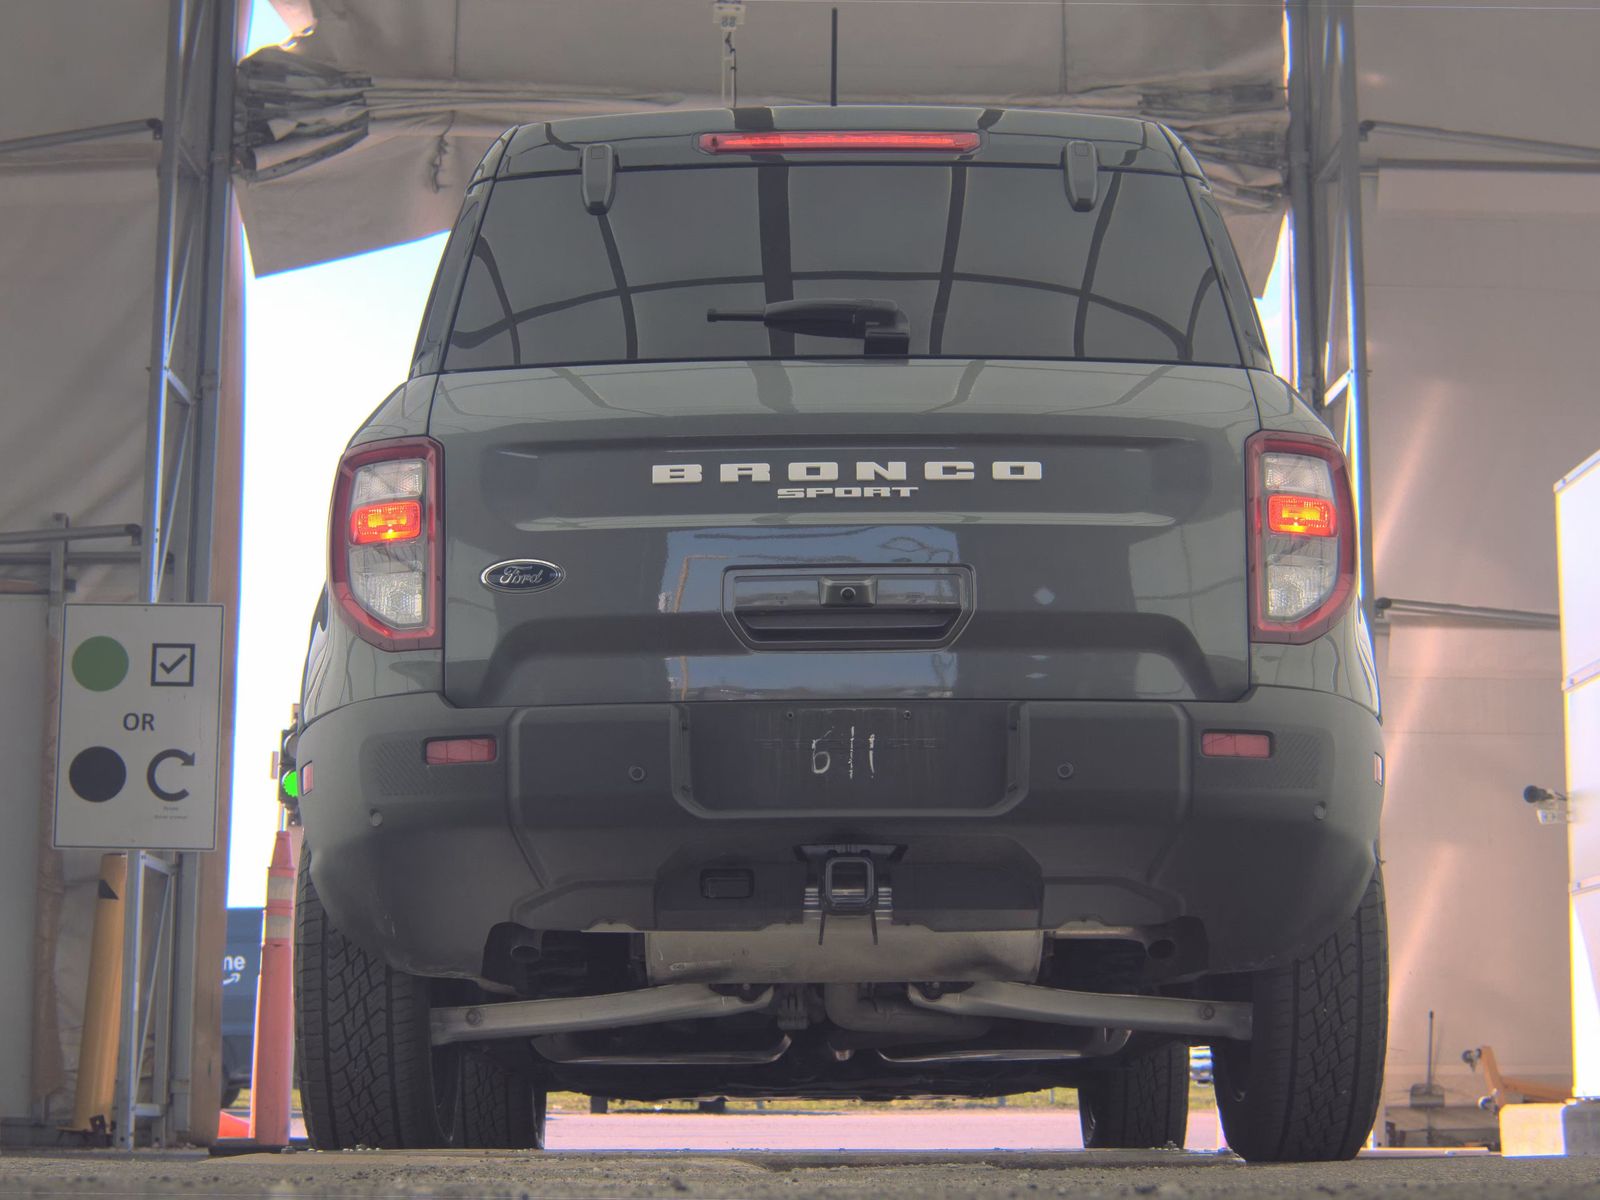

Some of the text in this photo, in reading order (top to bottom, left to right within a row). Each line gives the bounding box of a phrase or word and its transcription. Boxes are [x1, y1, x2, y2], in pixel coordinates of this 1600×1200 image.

[652, 461, 1042, 484] BRONCO
[777, 487, 919, 499] SPORT
[500, 564, 544, 584] Ford
[123, 713, 155, 731] OR
